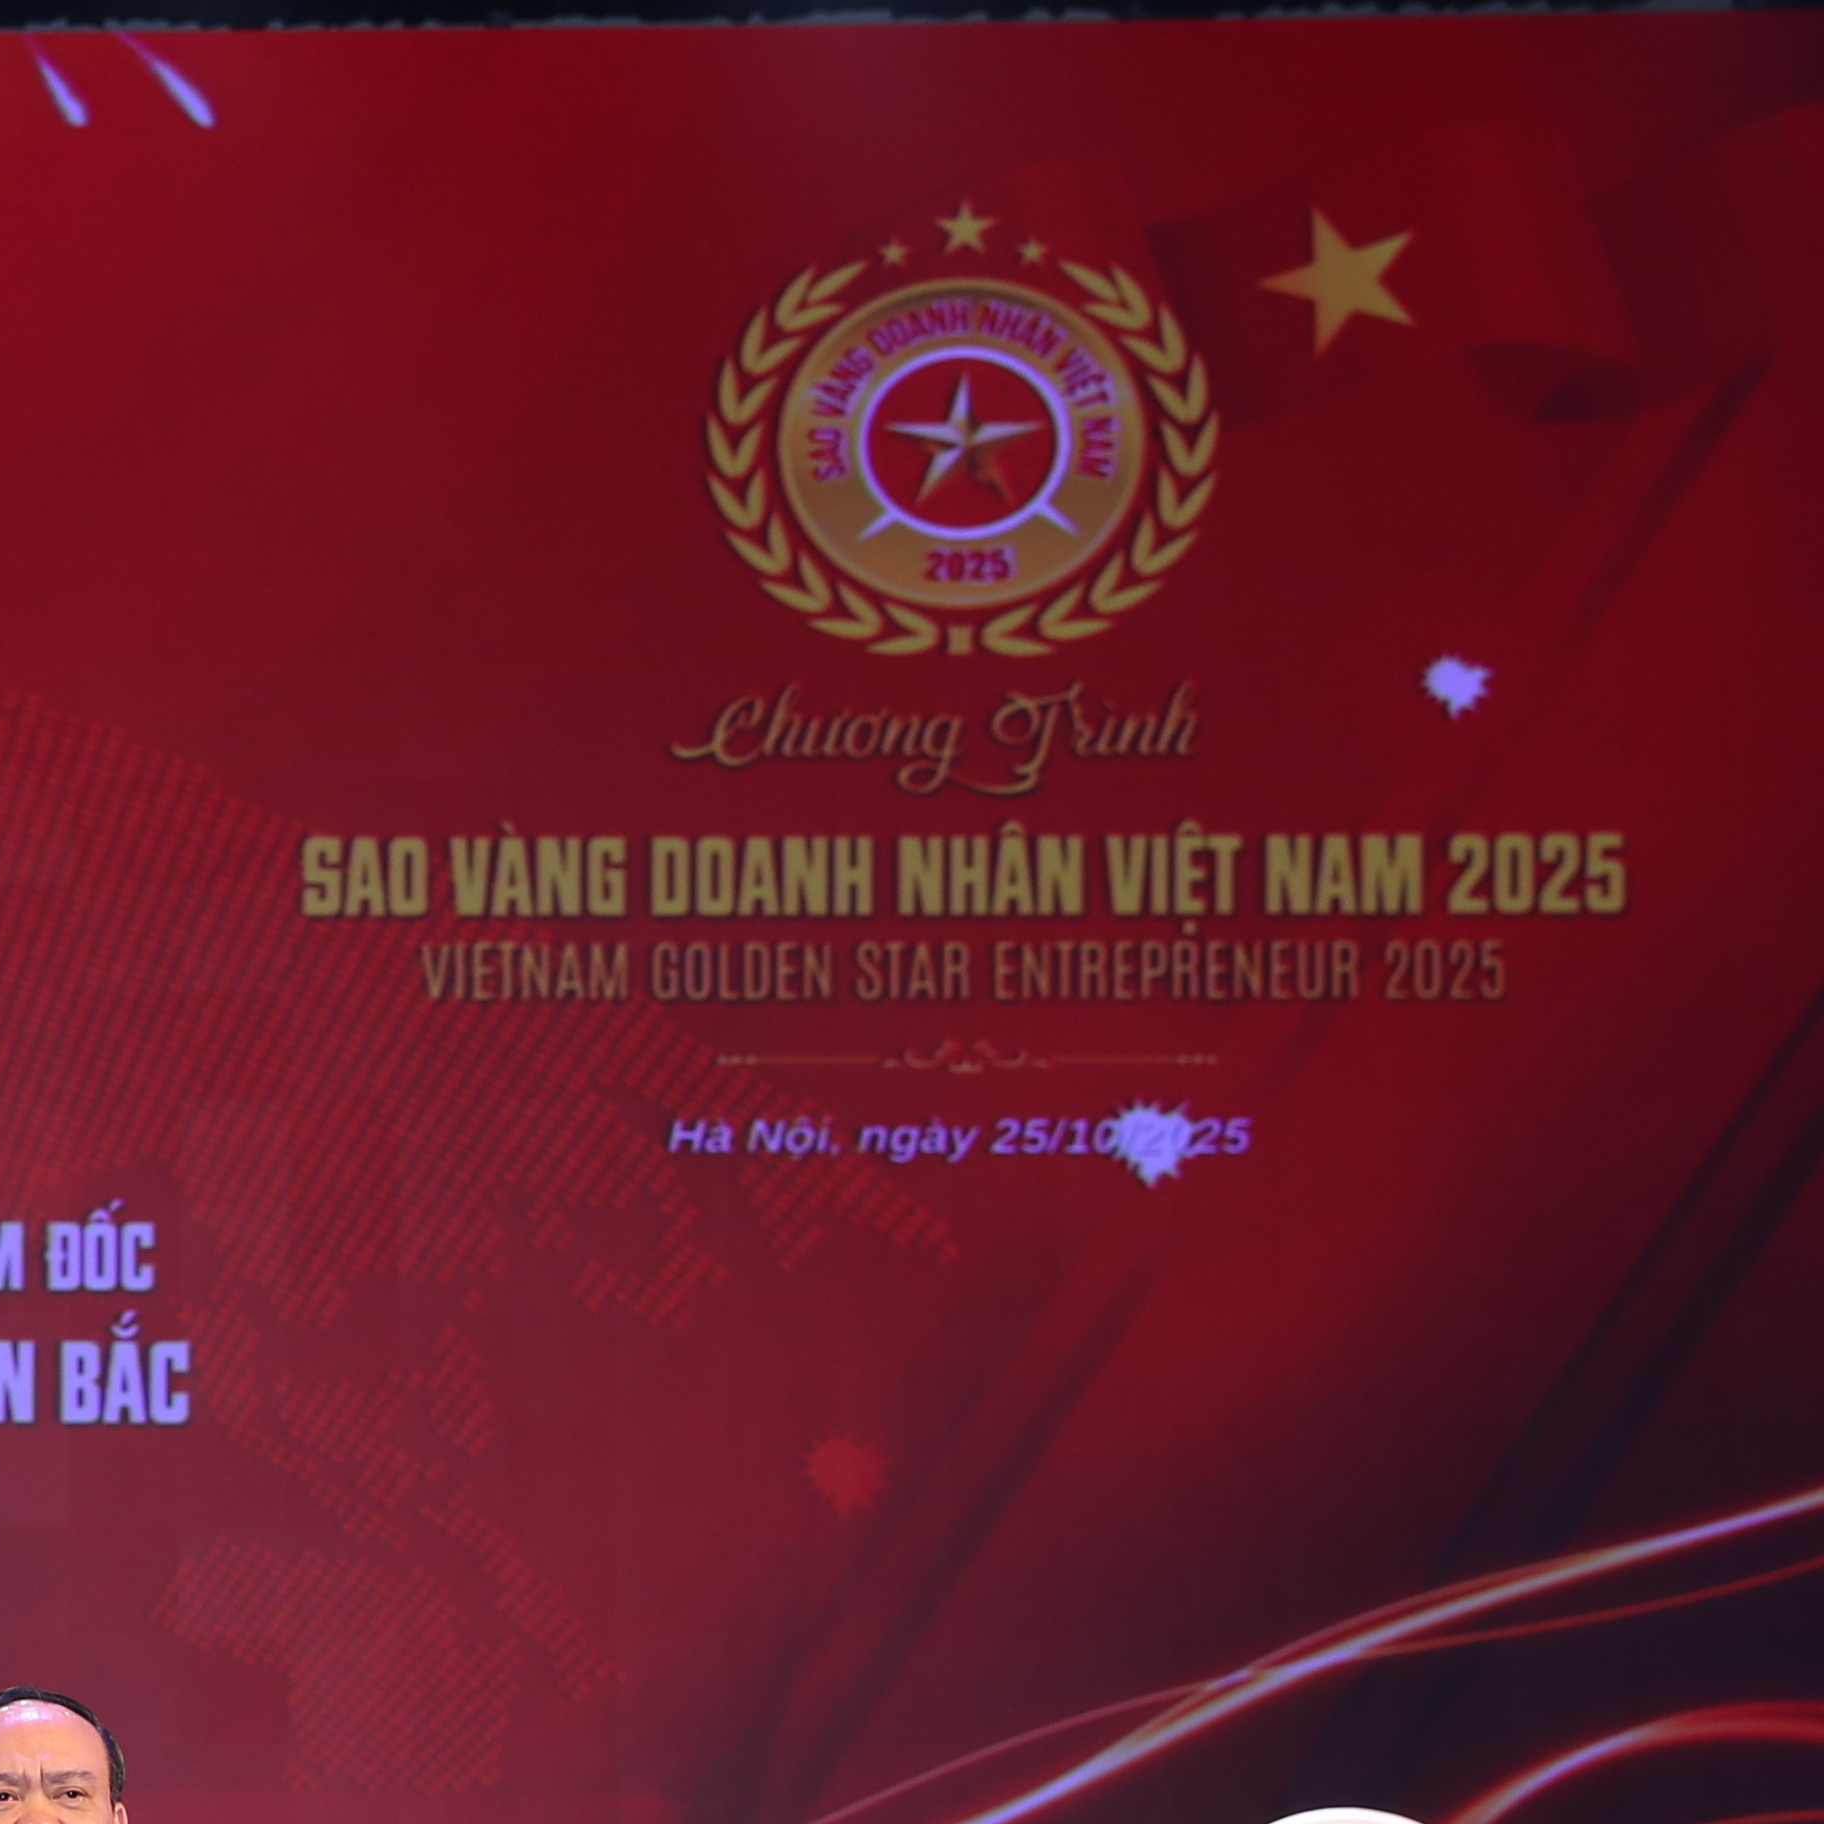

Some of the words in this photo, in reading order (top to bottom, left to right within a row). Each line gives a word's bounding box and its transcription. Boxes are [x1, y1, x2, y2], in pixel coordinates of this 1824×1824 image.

[922, 546, 1016, 584] 2025
[669, 680, 962, 793] Chương
[990, 682, 1200, 784] Trình
[300, 834, 428, 917] SAO
[450, 819, 626, 917] VÀNG
[650, 834, 873, 917] DOANH
[897, 819, 1084, 916] NHÂN
[1106, 819, 1242, 936] VIỆT
[1265, 834, 1423, 914] NAM
[1446, 832, 1626, 913] 2025
[420, 940, 629, 1001] VIETNAM
[650, 940, 834, 1001] GOLDEN
[855, 940, 971, 1000] STAR
[994, 940, 1362, 1000] ENTREPRENEUR
[1384, 938, 1507, 999] 2025
[668, 1116, 734, 1155] Hà
[746, 1116, 842, 1162] Nội,
[858, 1116, 979, 1164] ngày
[44, 1199, 156, 1292] ĐỐC
[58, 1309, 191, 1426] BẮC
